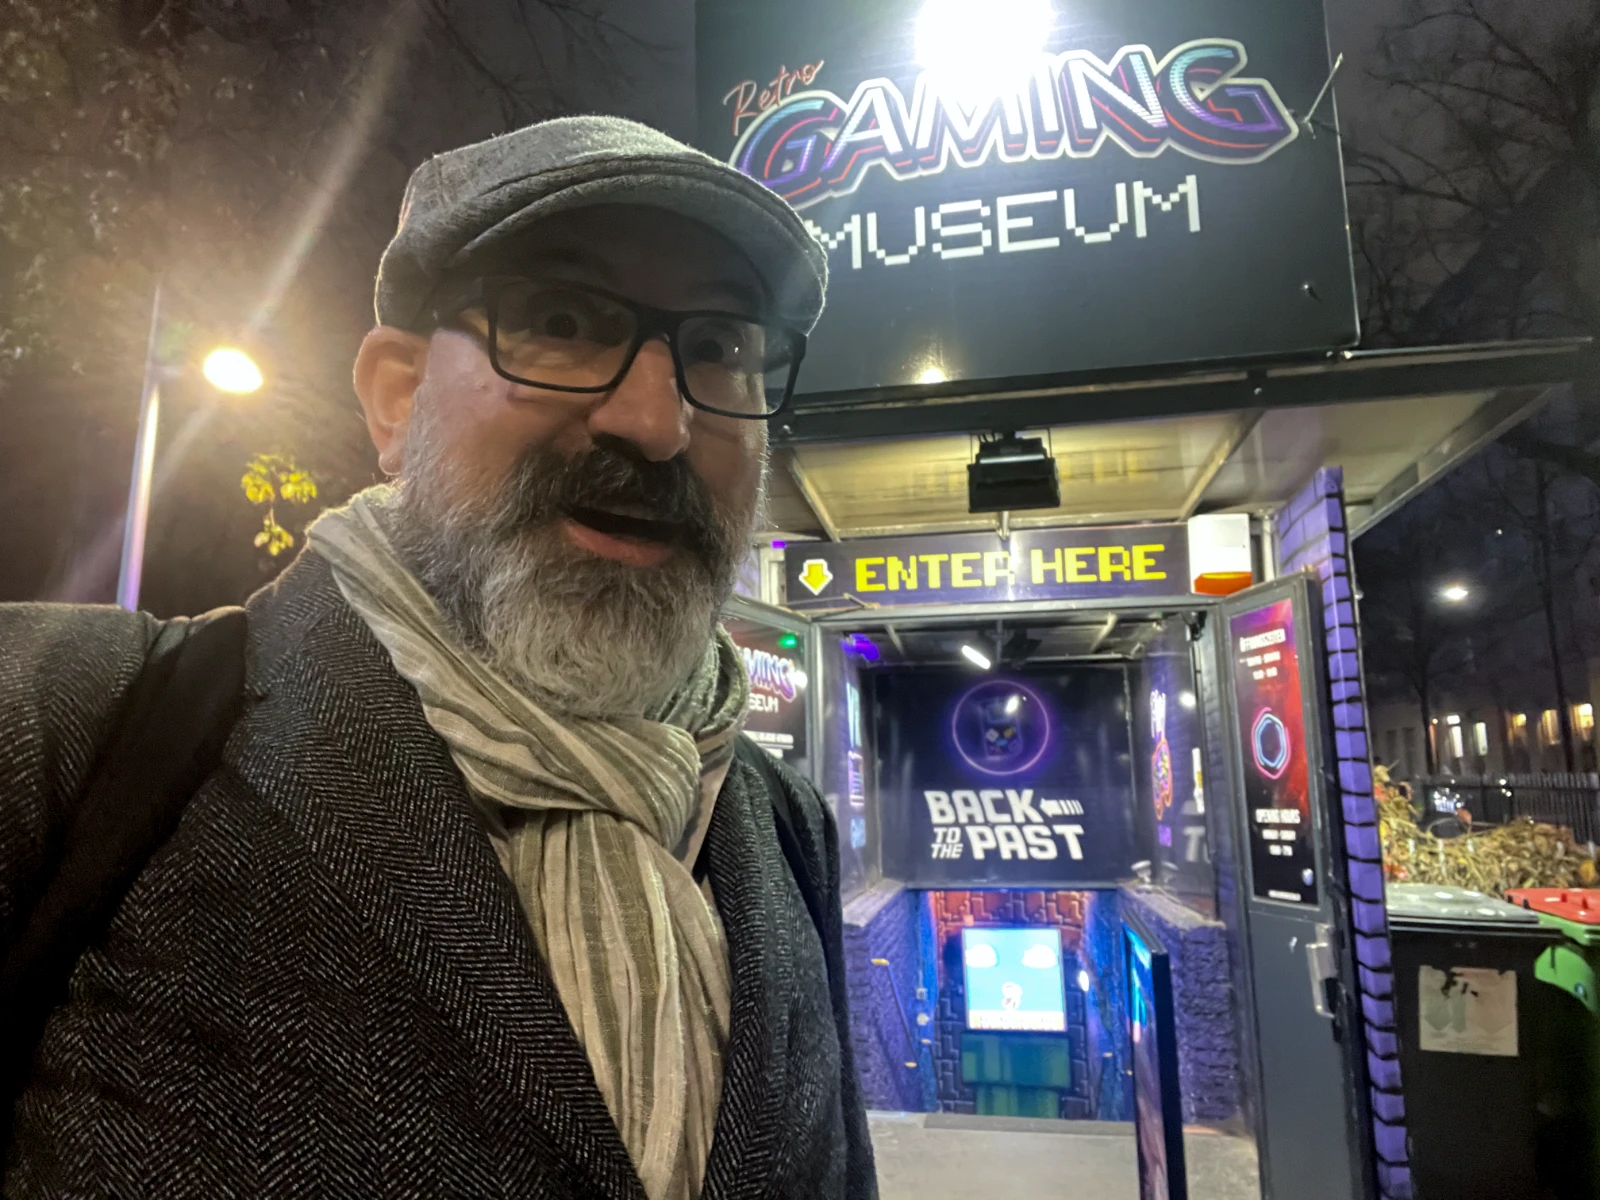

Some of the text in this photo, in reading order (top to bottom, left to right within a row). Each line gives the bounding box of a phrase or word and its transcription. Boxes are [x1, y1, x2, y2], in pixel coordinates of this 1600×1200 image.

[723, 59, 825, 136] Retro
[728, 37, 1299, 213] GAMING
[804, 174, 1201, 270] MUSEUM
[855, 543, 1167, 592] ENTER HERE
[923, 788, 1044, 825] BACK
[930, 824, 1085, 861] THE PAST
[933, 826, 961, 844] TO
